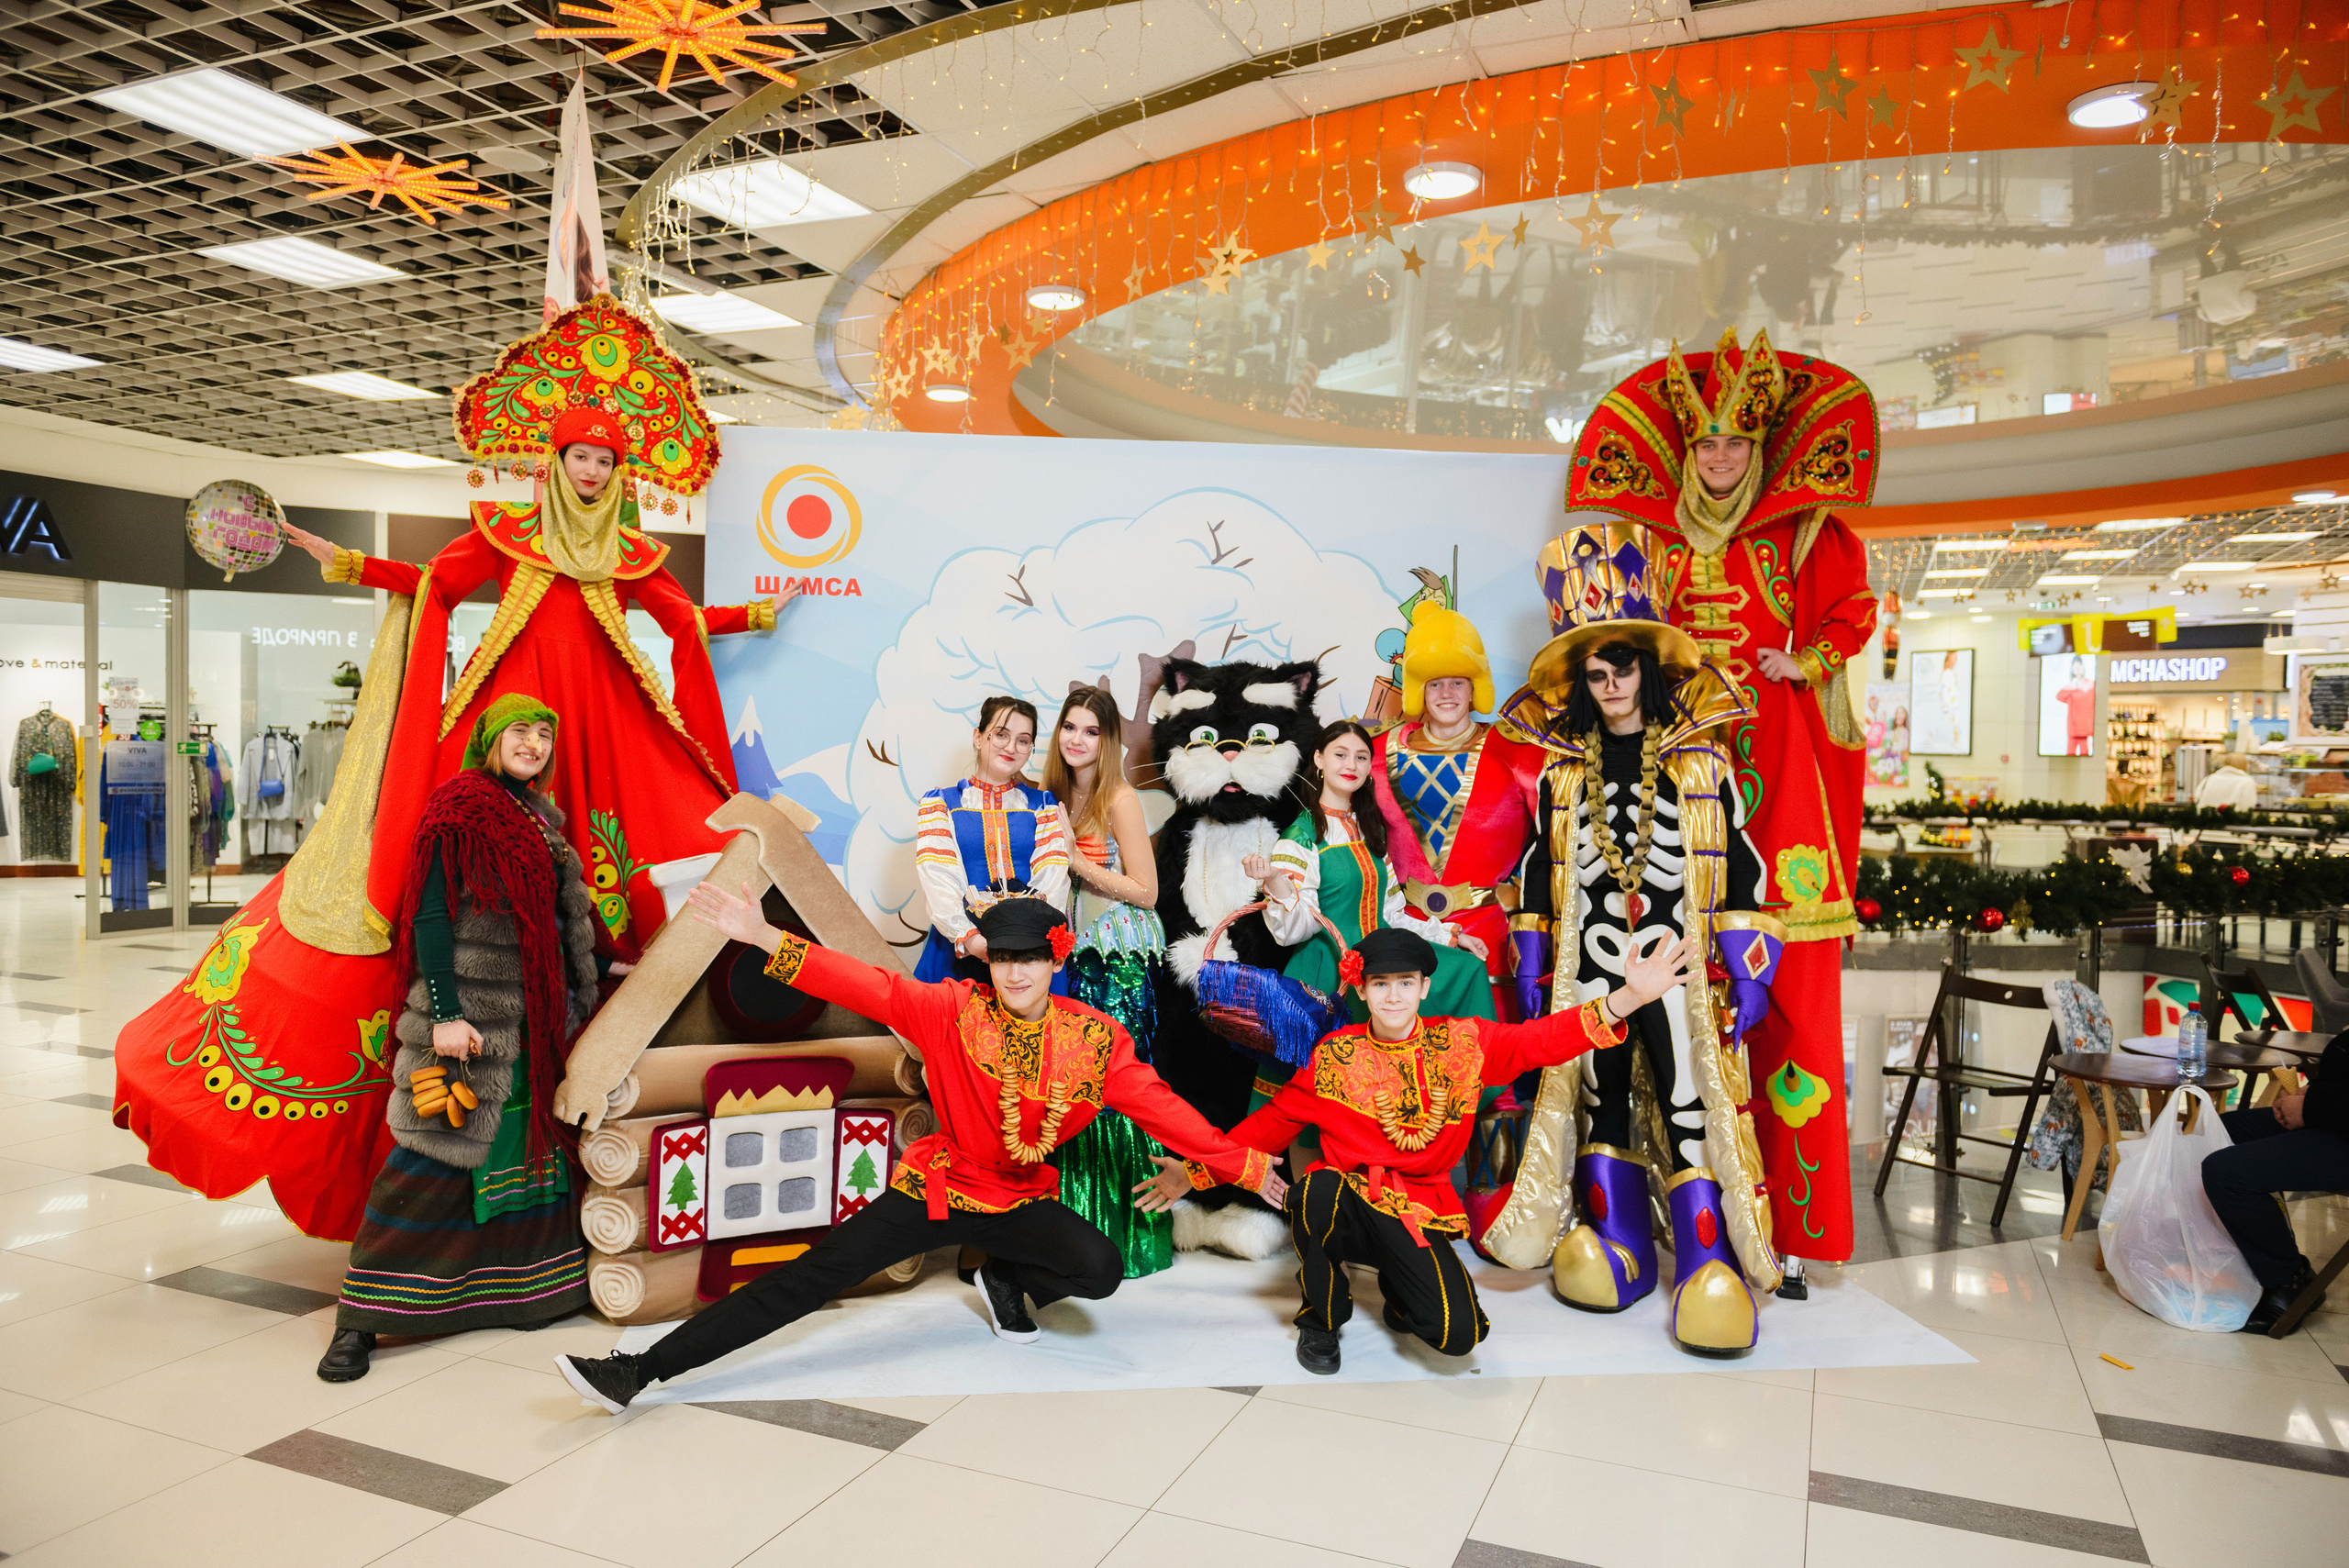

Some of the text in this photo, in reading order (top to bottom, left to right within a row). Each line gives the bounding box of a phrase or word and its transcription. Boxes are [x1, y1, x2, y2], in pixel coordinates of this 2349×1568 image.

[210, 508, 275, 534] НОВЫМ
[213, 526, 279, 552] ГОДОМ
[31, 659, 41, 668] &
[45, 660, 112, 670] mateal
[113, 699, 137, 709] 50%
